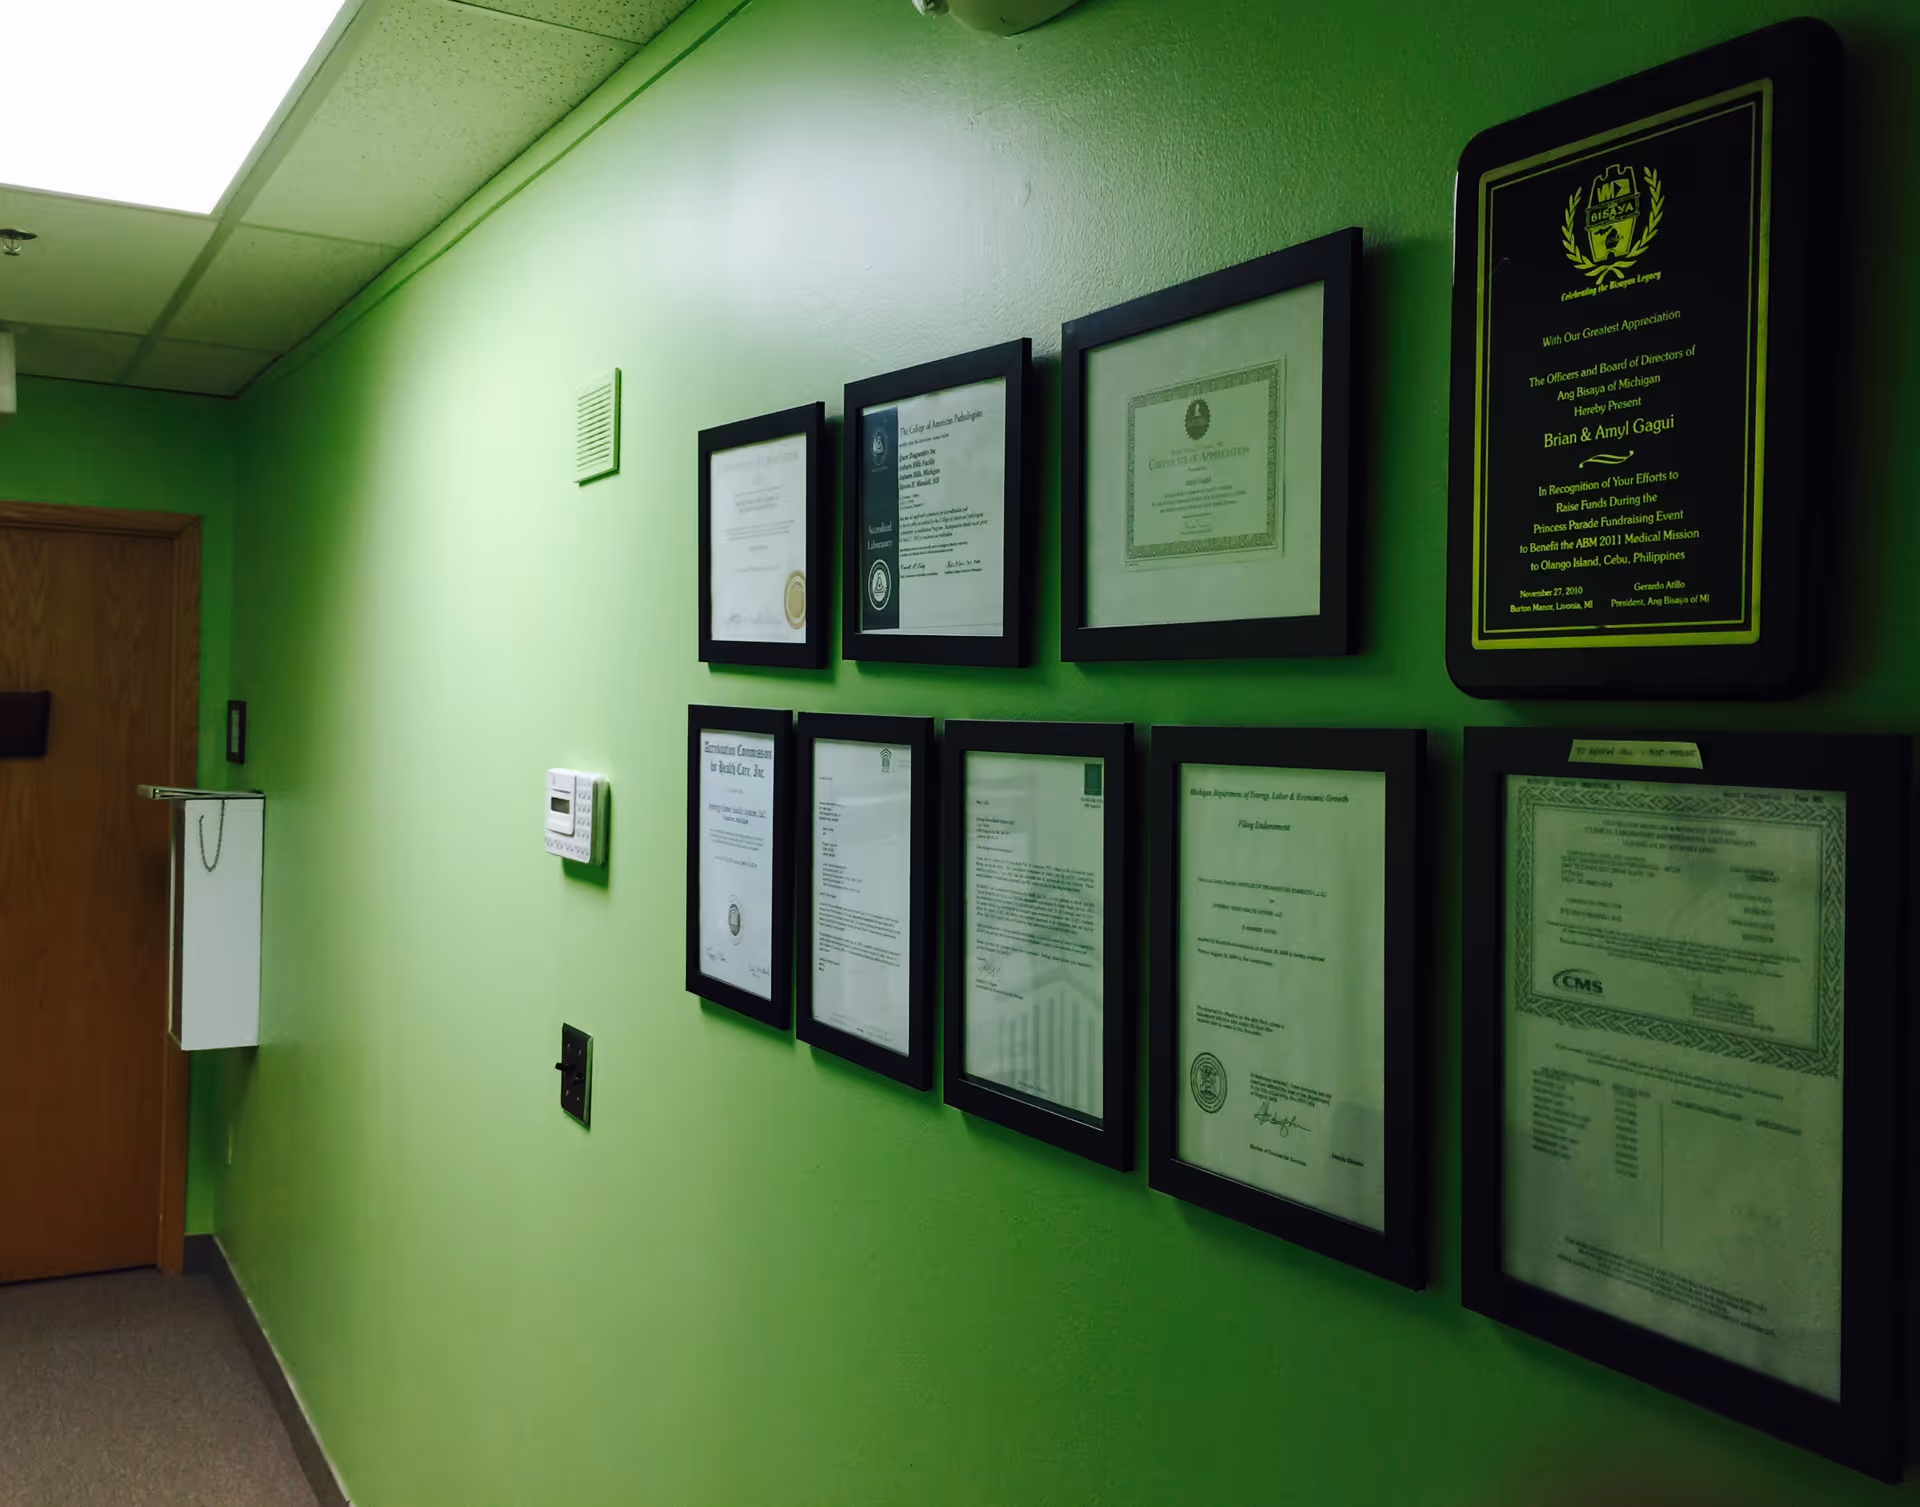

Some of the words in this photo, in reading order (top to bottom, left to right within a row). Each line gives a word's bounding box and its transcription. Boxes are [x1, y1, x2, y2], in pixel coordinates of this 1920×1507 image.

[1591, 202, 1634, 222] BISAYA
[1637, 271, 1661, 284] Legacy
[1542, 335, 1562, 348] With
[1564, 332, 1580, 343] Our
[1582, 322, 1619, 339] Greatest
[1621, 310, 1681, 332] Appreciation
[1528, 376, 1545, 388] The
[1546, 369, 1579, 384] Officers
[1580, 364, 1597, 377] and
[1599, 359, 1627, 374] Board
[1629, 356, 1639, 368] of
[1640, 350, 1683, 366] Directors
[1685, 344, 1696, 356] of
[1557, 390, 1575, 402] Ang
[1576, 384, 1605, 400] Bisaya
[1607, 380, 1617, 392] of
[1618, 374, 1660, 391] Michigan
[1574, 403, 1606, 418] Hereby
[1608, 396, 1642, 412] Present
[1544, 432, 1577, 448] Brian
[1580, 427, 1592, 442] &
[1595, 420, 1629, 440] Amyl
[1633, 414, 1675, 435] Gagui
[1538, 486, 1547, 497] In
[1548, 480, 1599, 497] Recognition
[1601, 477, 1611, 489] of
[1612, 475, 1634, 487] Your
[1635, 472, 1667, 485] Efforts
[1668, 471, 1679, 481] to
[1556, 502, 1579, 513] Raise
[1580, 497, 1607, 510] Funds
[1609, 494, 1640, 508] During
[1642, 492, 1657, 503] the
[1533, 522, 1567, 535] Princess
[1568, 518, 1599, 531] Parade
[1600, 513, 1654, 529] Fundraising
[1656, 509, 1684, 522] Event
[1519, 544, 1528, 554] to
[1529, 541, 1559, 553] Benefit
[1560, 539, 1574, 550] the
[1575, 536, 1598, 549] ABM
[1599, 534, 1621, 547] 2011
[1624, 530, 1661, 545] Medical
[1663, 529, 1700, 542] Mission
[1530, 562, 1539, 572] to
[1540, 558, 1571, 572] Olango
[1573, 556, 1602, 568] Island,
[1633, 550, 1686, 565] Philippines
[1519, 588, 1553, 599] November
[1553, 587, 1564, 597] 27,
[1565, 586, 1583, 596] 2010
[1633, 580, 1664, 591] Gerardo
[1584, 599, 1593, 609] MI
[1647, 596, 1663, 608] Ang
[1663, 595, 1689, 606] Bisaya
[1689, 594, 1699, 604] of
[1699, 593, 1710, 604] MI
[1562, 975, 1603, 993] CMS
